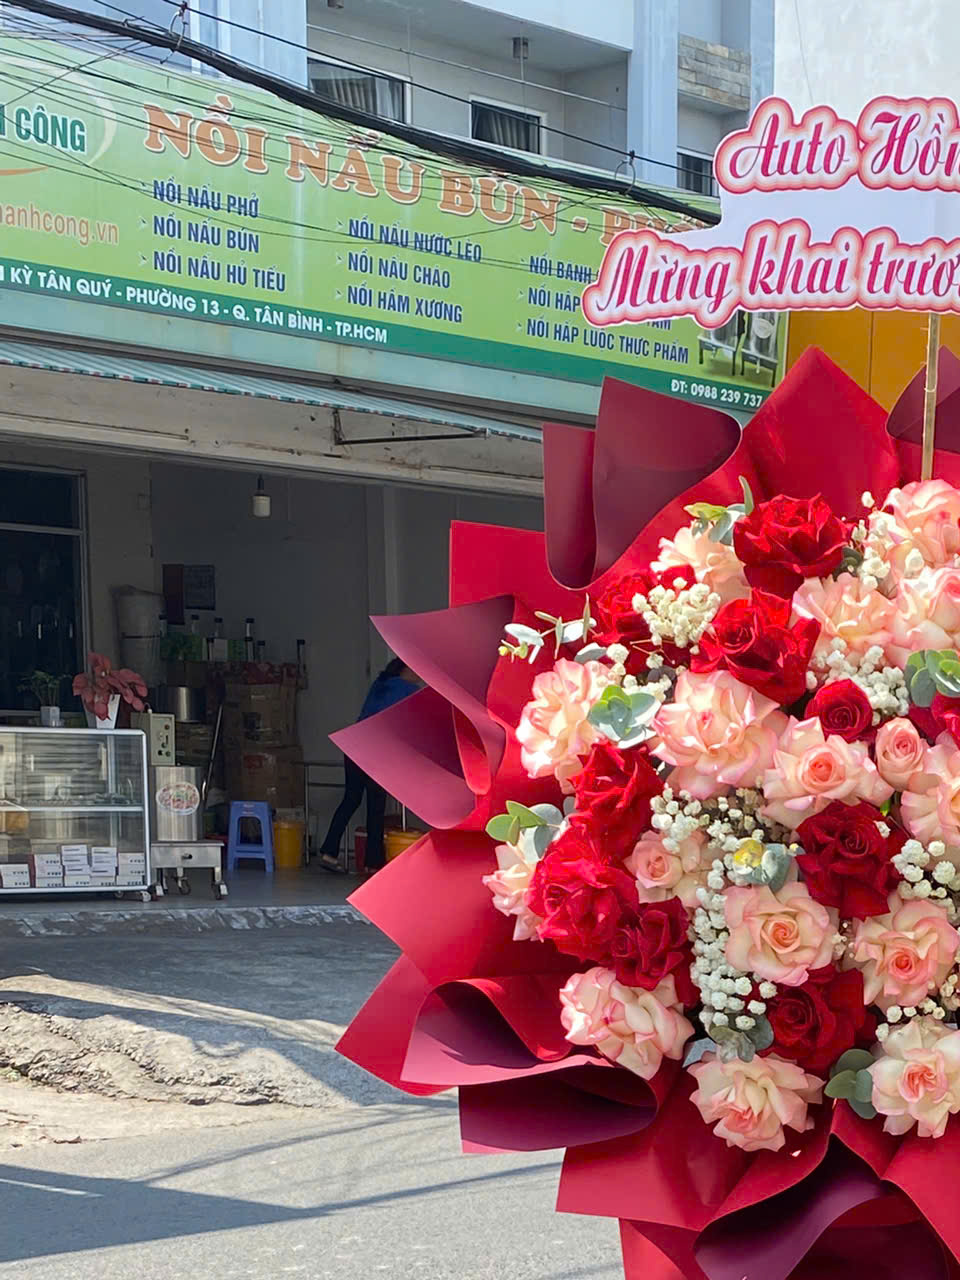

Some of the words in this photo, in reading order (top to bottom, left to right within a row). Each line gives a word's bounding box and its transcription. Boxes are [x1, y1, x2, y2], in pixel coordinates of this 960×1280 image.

[15, 105, 86, 152] CÔNG
[729, 113, 849, 179] Auto
[227, 192, 259, 218] PHỞ
[227, 226, 259, 253] BÚN
[226, 260, 247, 285] HỦ
[252, 265, 286, 292] TIẾU
[596, 245, 732, 314] Mừng
[748, 233, 851, 295] khai
[10, 265, 33, 285] KỲ
[37, 270, 72, 292] TÂN
[76, 279, 112, 299] QUÝ
[126, 286, 197, 312] PHƯỜNG
[202, 299, 220, 316] 13
[232, 305, 250, 321] Q.
[254, 306, 284, 326] TÂN
[287, 310, 323, 333] BÌNH
[335, 321, 388, 344] TP.HCM
[415, 298, 462, 323] XƯƠNG
[671, 379, 688, 394] ĐT:
[690, 383, 718, 399] 0988
[720, 389, 741, 404] 239
[743, 393, 763, 408] 737
